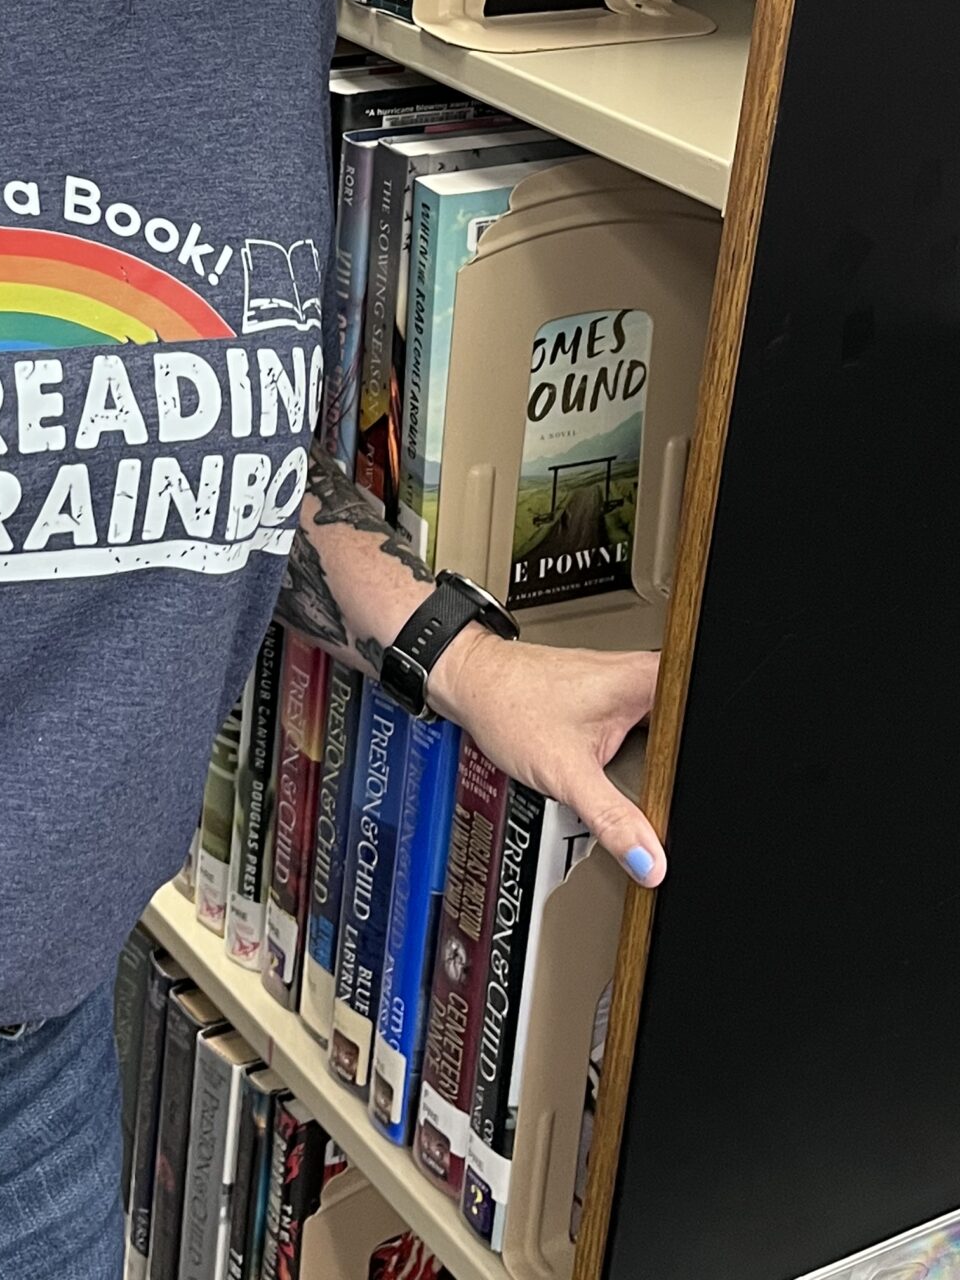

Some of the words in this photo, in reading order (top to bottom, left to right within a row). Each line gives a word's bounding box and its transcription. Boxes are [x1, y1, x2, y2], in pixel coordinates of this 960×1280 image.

[377, 105, 414, 117] hurricane
[415, 102, 448, 114] blowing
[342, 164, 356, 207] RORY
[381, 179, 392, 213] THE
[3, 176, 42, 216] a
[63, 175, 234, 285] Book!
[416, 201, 431, 261] WHEN
[373, 222, 391, 318] SOWING
[413, 286, 427, 335] ROAD
[368, 322, 384, 417] SEASON
[408, 338, 423, 393] COMES
[527, 358, 647, 422] OUND
[406, 392, 421, 461] AROUND
[540, 433, 546, 441] A
[548, 430, 577, 440] NOVEL
[515, 582, 581, 601] AWARD-WINNING
[583, 575, 615, 588] AUTHOR
[539, 541, 629, 579] POWNE
[254, 705, 272, 769] CANYON
[280, 663, 310, 766] PRESTON
[323, 682, 352, 795] PRESTON
[361, 713, 395, 817] PRESTON
[244, 779, 265, 859] DOUGLAS
[273, 799, 298, 886] CHILD
[447, 814, 470, 880] LINCOLN
[465, 810, 494, 882] DOUGLAS
[312, 814, 337, 905] CHILD
[352, 840, 379, 922] CHILD
[491, 817, 531, 955] PRESTON
[443, 871, 463, 920] CHILD
[458, 874, 486, 942] PRESTON
[354, 964, 373, 1017] BLUE
[391, 995, 406, 1035] CITY
[428, 996, 447, 1077] DANCE
[438, 991, 469, 1108] CEMETERY
[479, 980, 510, 1082] CHILD
[280, 1204, 293, 1243] THE
